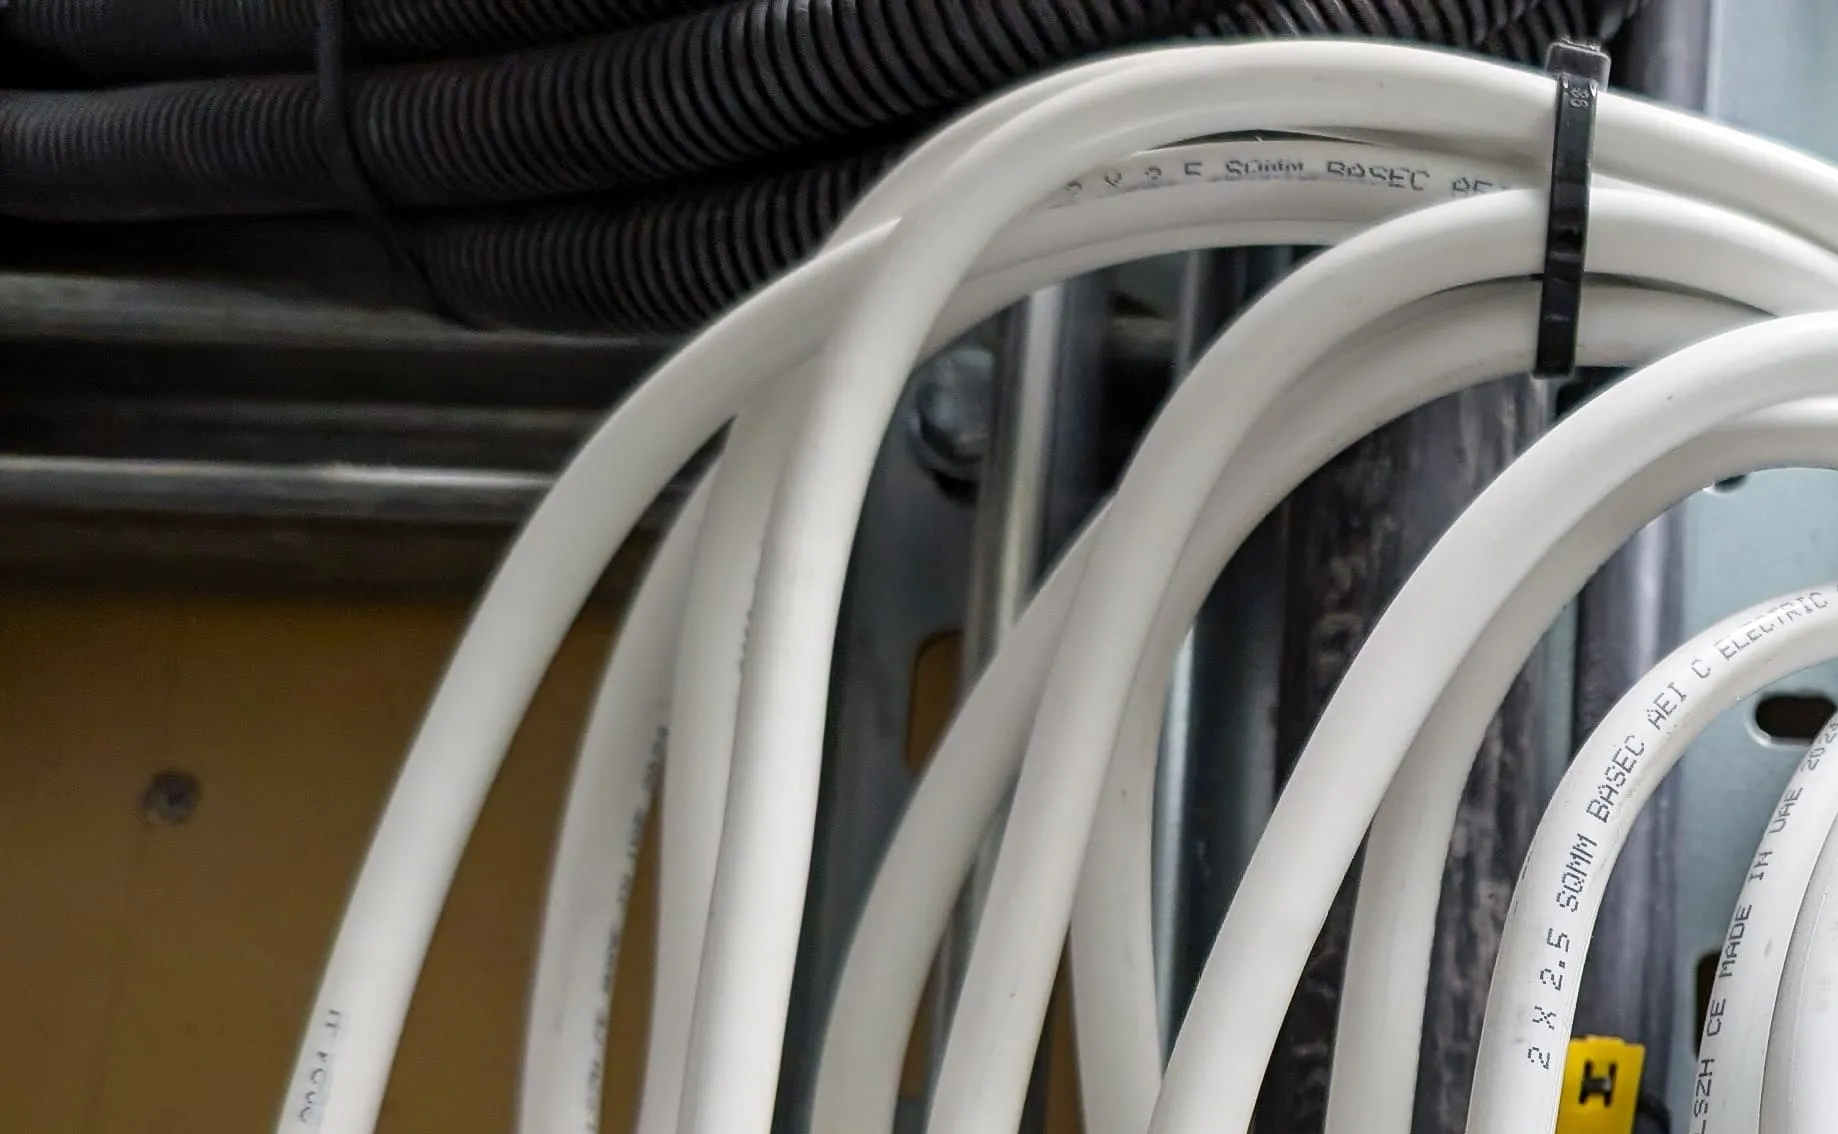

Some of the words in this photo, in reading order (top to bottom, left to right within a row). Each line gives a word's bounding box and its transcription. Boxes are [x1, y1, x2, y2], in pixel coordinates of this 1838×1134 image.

[1714, 589, 1829, 663] ELECTRIC
[1648, 681, 1688, 731] AEI
[1586, 733, 1649, 824] BASEC
[1539, 931, 1571, 991] 2.5
[1706, 997, 1727, 1037] CE
[1719, 902, 1753, 979] MADE
[1748, 848, 1774, 882] IN
[1528, 1047, 1552, 1069] 2
